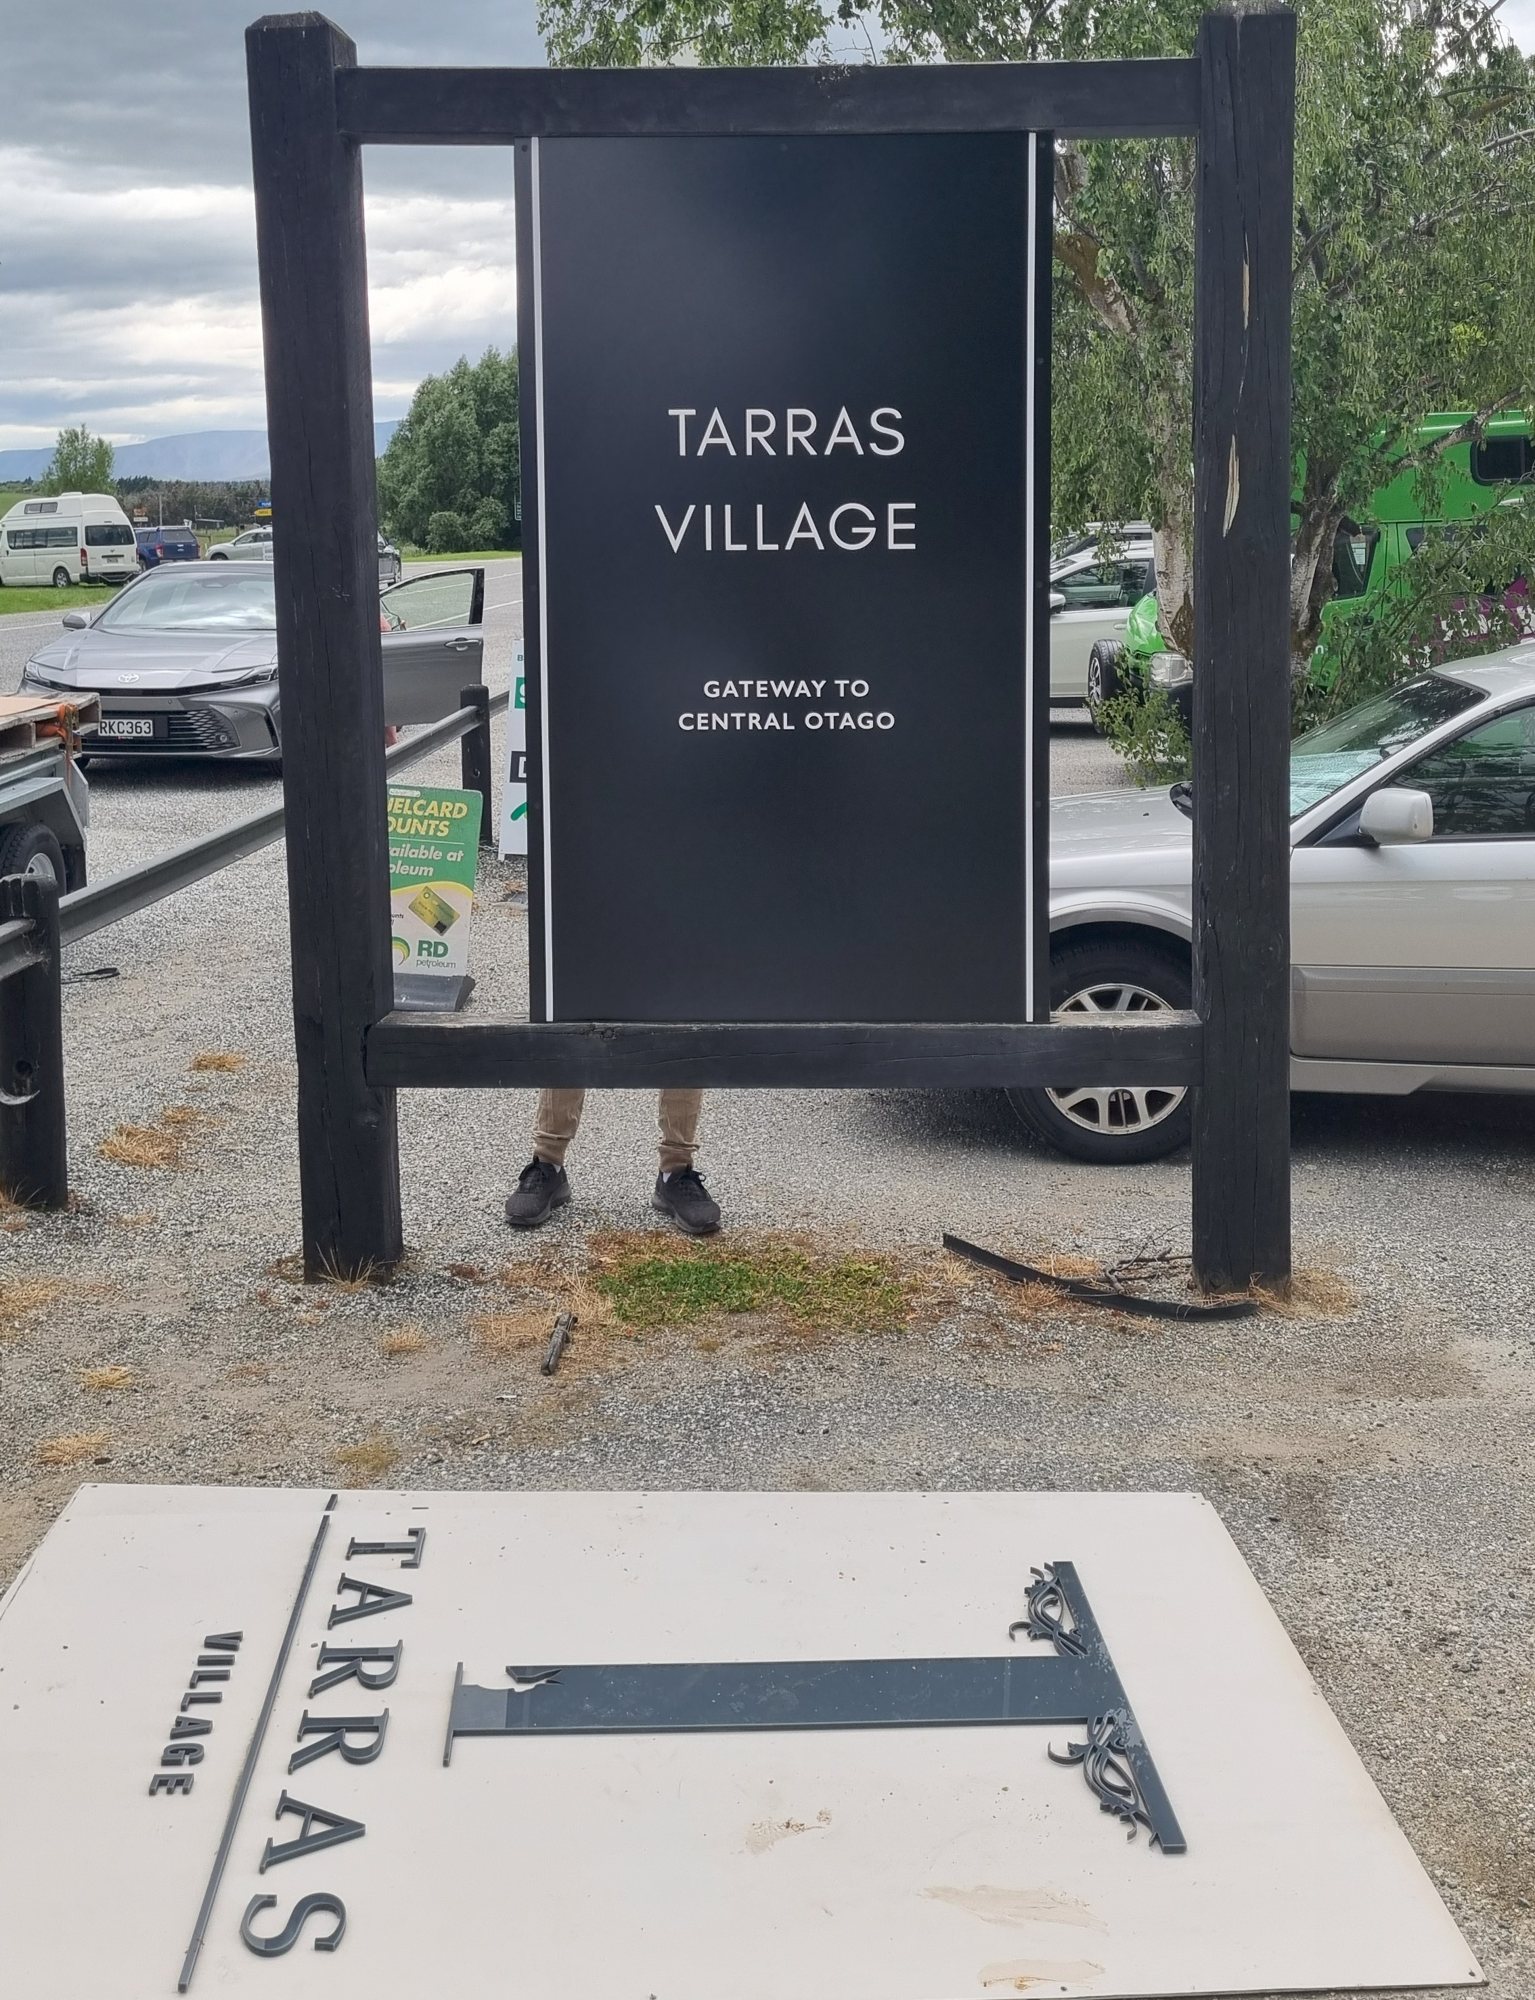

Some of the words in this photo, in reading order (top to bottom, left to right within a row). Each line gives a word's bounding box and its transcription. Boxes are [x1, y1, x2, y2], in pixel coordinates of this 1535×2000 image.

[668, 405, 905, 456] TARRAS
[654, 501, 917, 553] VILLAGE
[703, 680, 827, 698] GATEWAY
[834, 679, 870, 697] TO
[100, 721, 152, 735] RKC363
[678, 712, 795, 731] CENTRAL
[804, 711, 895, 730] OTAGO
[389, 844, 443, 860] ailable
[446, 850, 464, 862] at
[417, 939, 449, 958] RD
[416, 959, 457, 969] petroleum
[148, 1630, 244, 1797] VILLAGE
[238, 1526, 427, 1958] TARRAS
